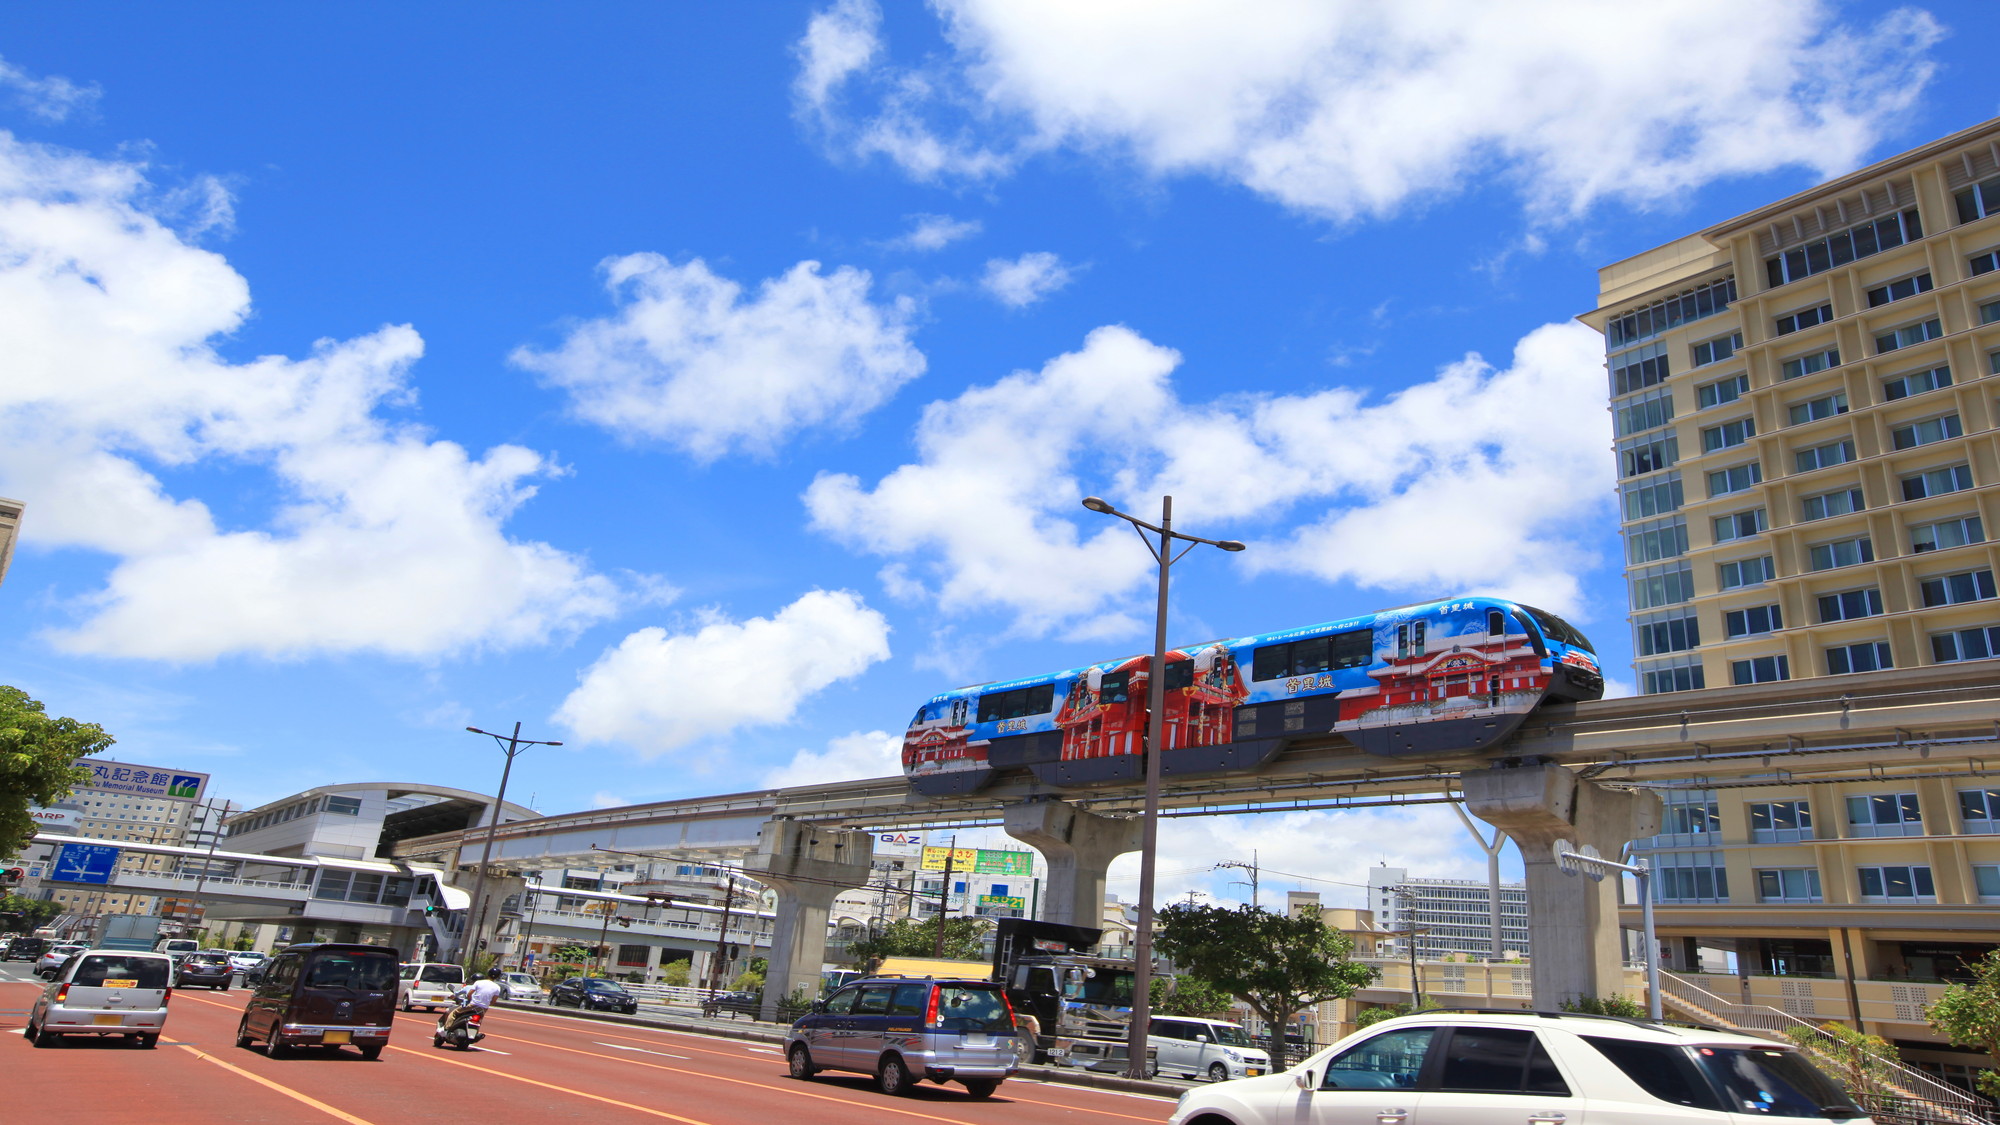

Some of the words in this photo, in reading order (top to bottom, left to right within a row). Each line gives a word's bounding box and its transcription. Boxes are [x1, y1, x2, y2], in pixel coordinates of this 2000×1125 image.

[1439, 601, 1475, 615] 首里城
[1286, 674, 1335, 694] 首里城
[996, 719, 1028, 734] 首里城
[102, 781, 135, 792] Memorial
[136, 785, 165, 795] Museum
